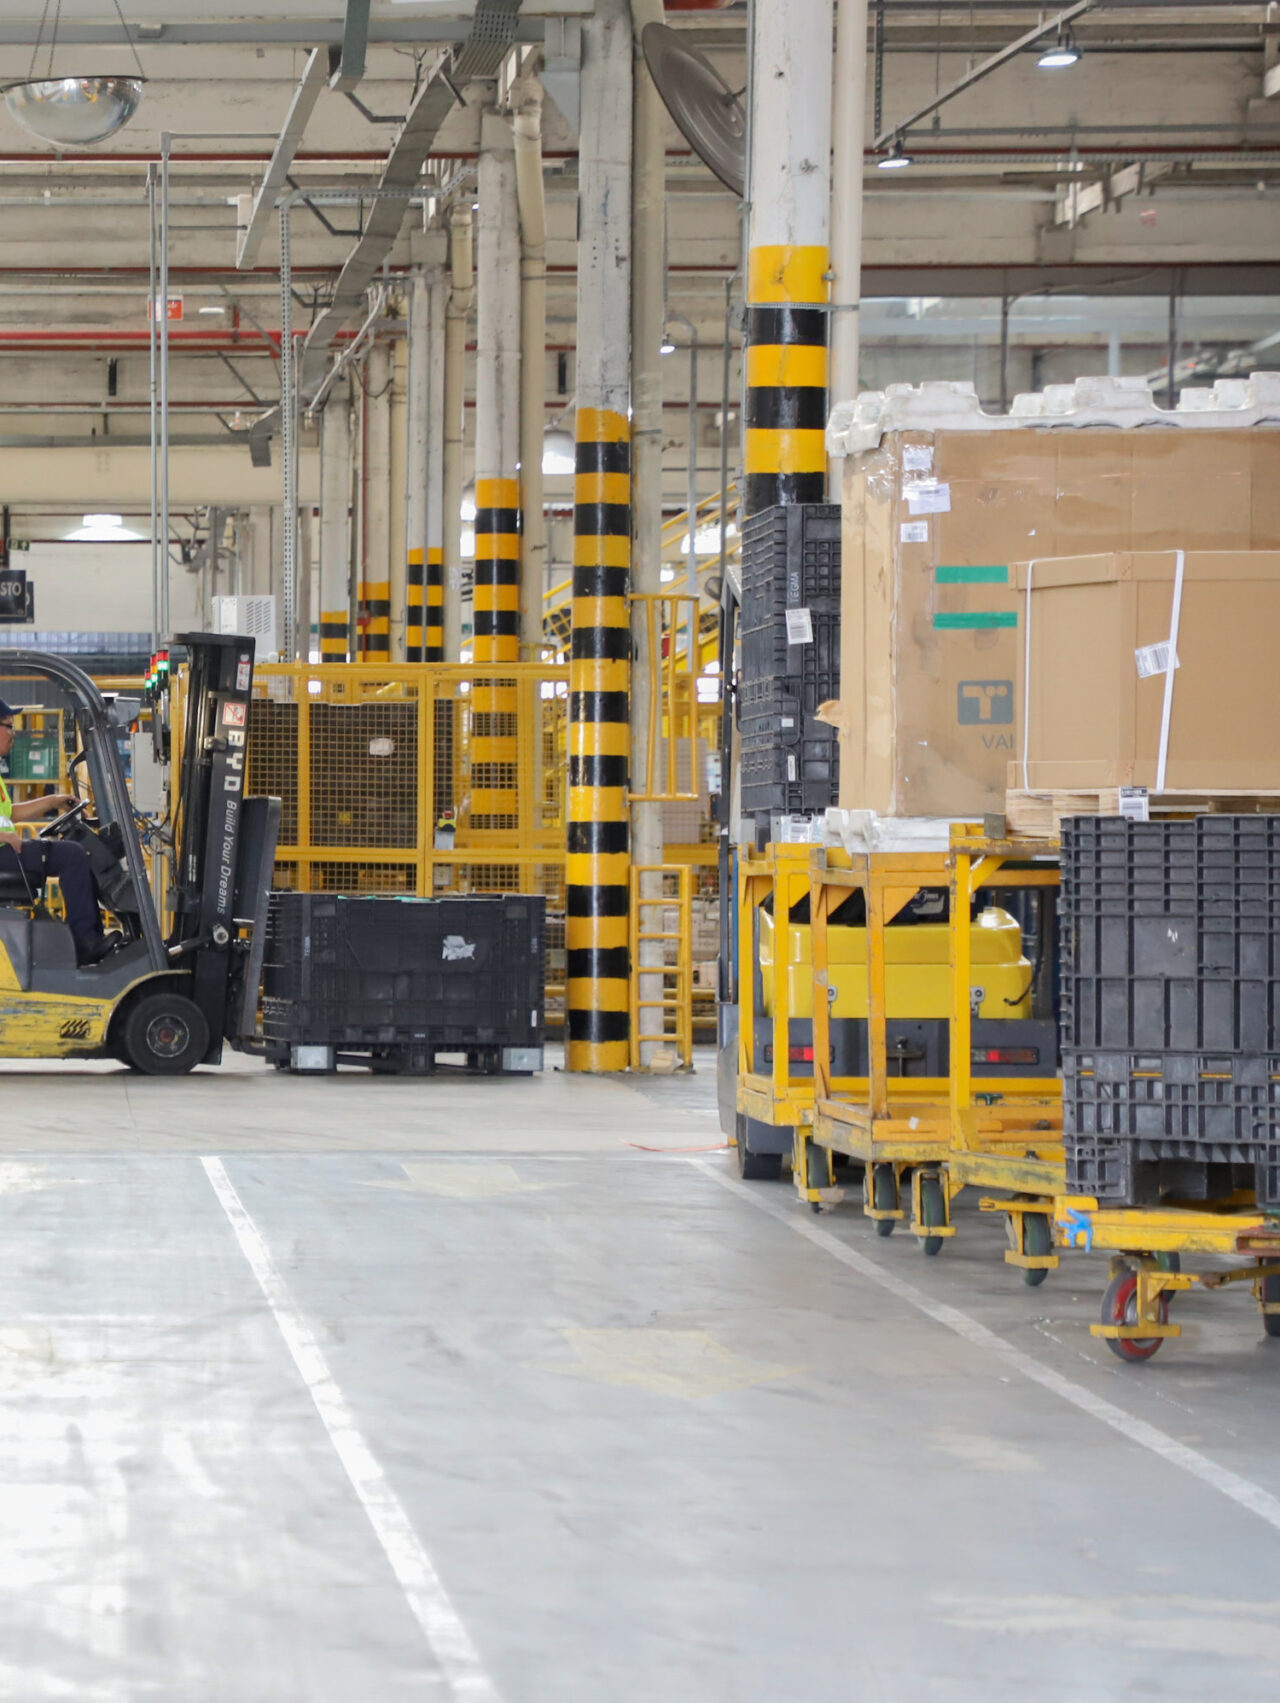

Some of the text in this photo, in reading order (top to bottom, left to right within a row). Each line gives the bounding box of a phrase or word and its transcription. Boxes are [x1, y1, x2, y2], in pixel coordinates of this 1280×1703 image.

[790, 571, 799, 604] TEGMA
[216, 730, 245, 916] BYD Build Your Dreams
